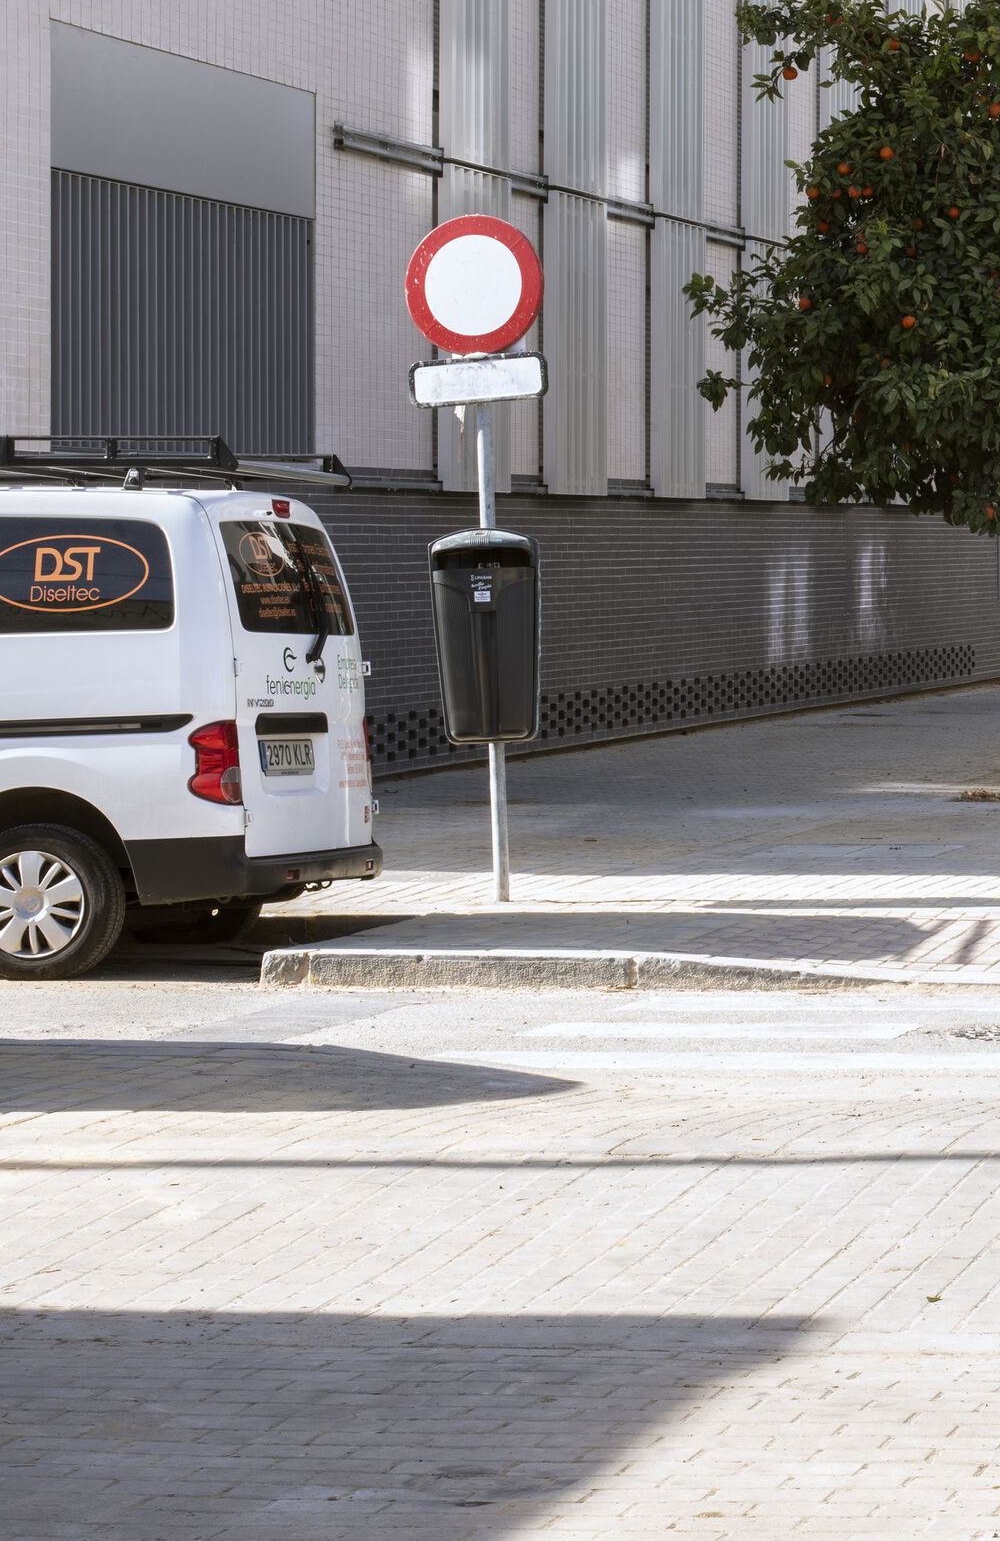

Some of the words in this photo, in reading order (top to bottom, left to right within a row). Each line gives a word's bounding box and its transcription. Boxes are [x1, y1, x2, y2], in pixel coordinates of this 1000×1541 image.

[248, 536, 273, 560] DST
[34, 546, 101, 582] DST
[30, 585, 100, 602] Diseltec
[247, 699, 274, 707] NV200
[267, 745, 293, 766] 2970
[294, 744, 312, 765] KLR
